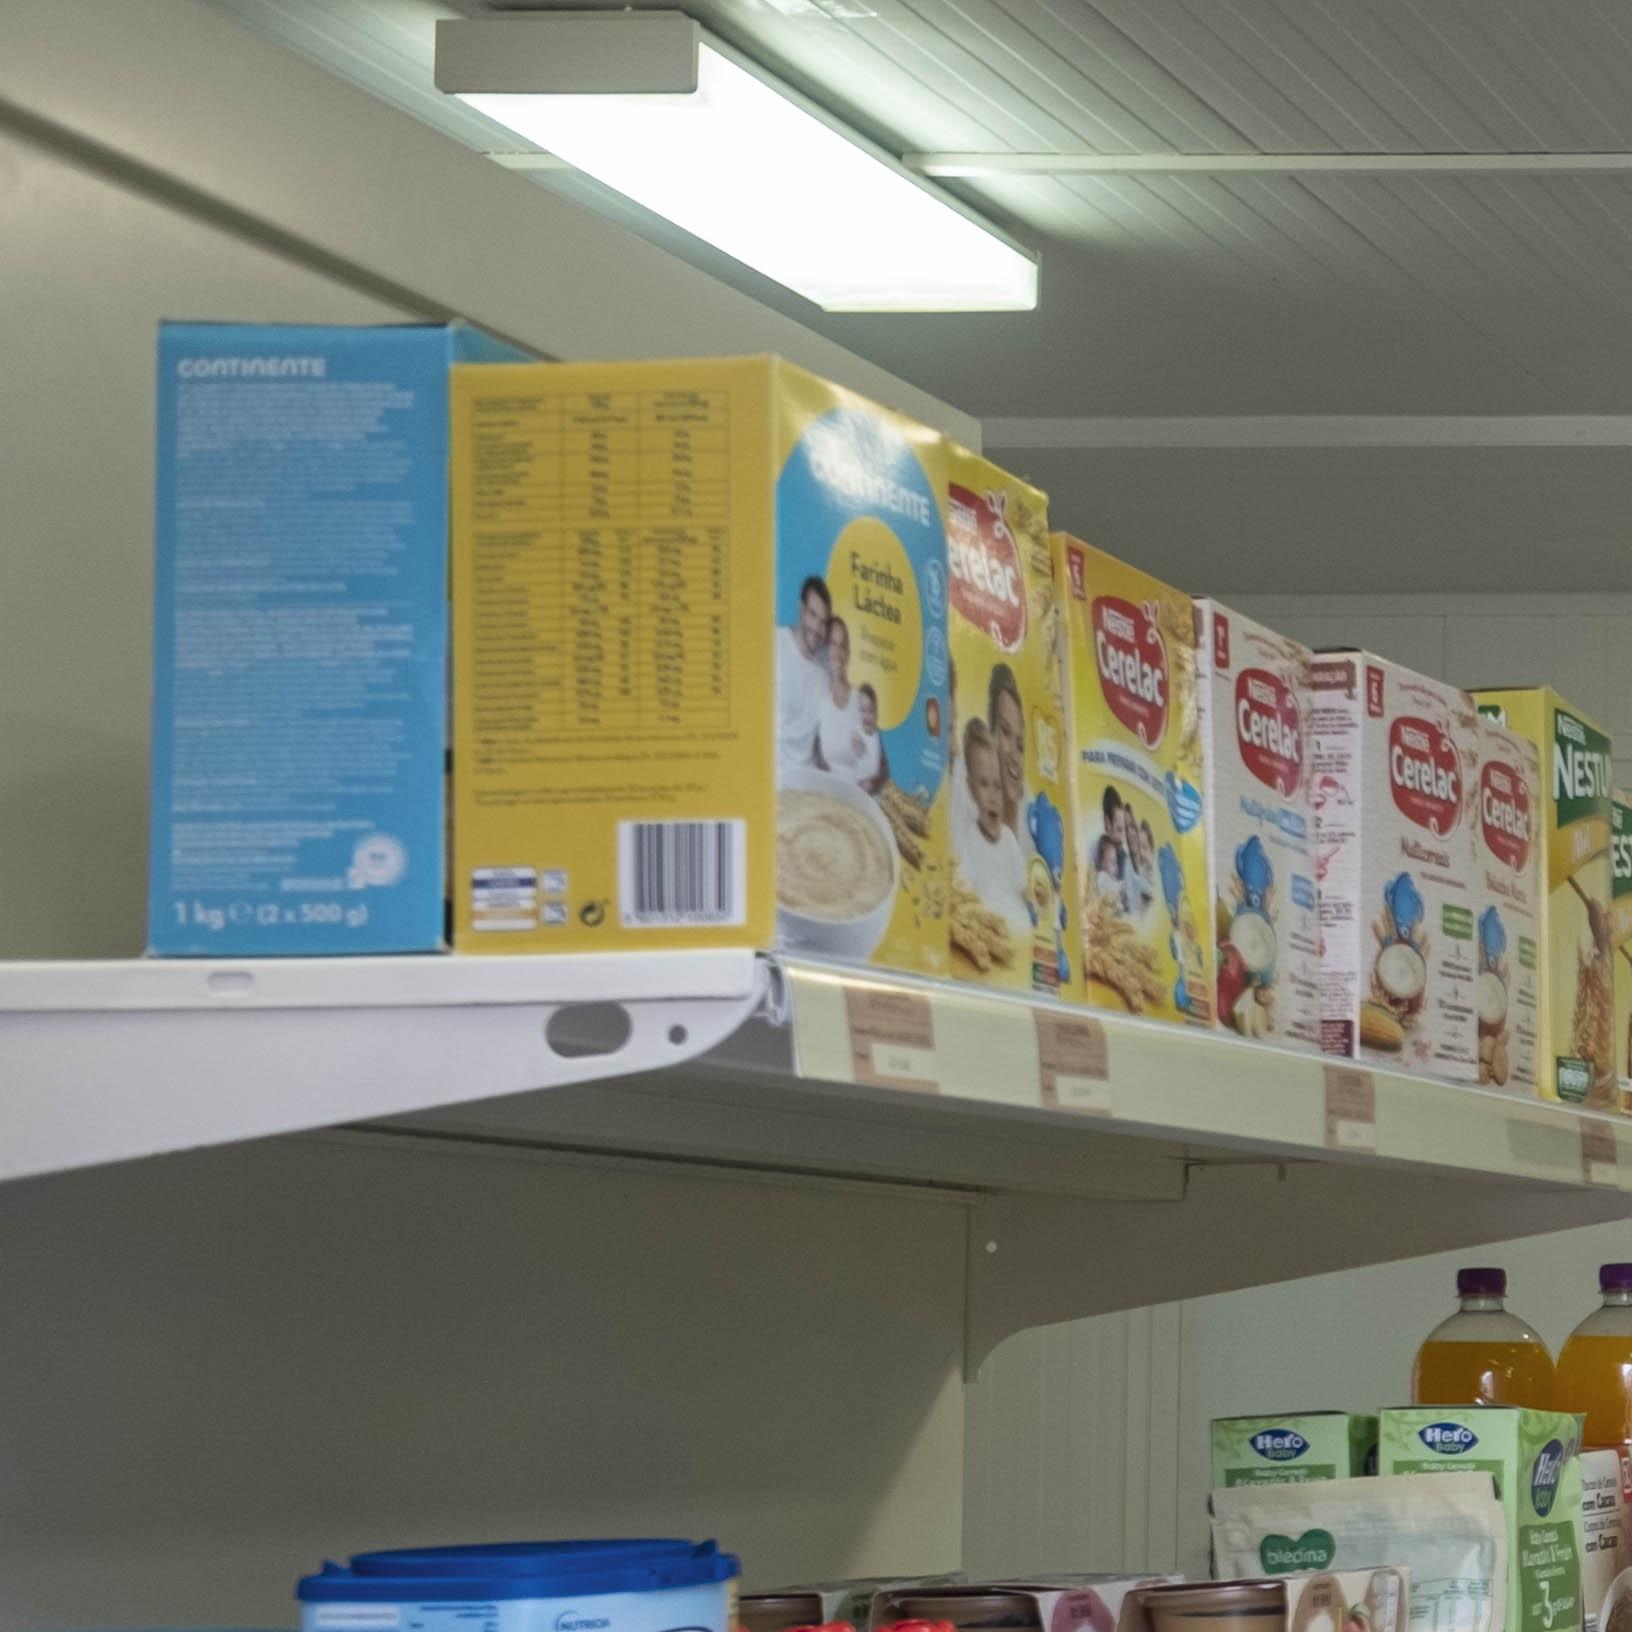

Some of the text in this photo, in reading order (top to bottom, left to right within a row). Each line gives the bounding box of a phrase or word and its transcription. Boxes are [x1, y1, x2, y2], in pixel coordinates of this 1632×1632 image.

[850, 551, 904, 596] Farinha
[949, 528, 1020, 608] erelac
[1096, 630, 1164, 709] Cerelac
[1238, 698, 1300, 763] Cerelac
[1391, 744, 1458, 805] Cerelac
[1552, 742, 1612, 802] NESTU
[1483, 787, 1530, 843] Cerelac
[1255, 1431, 1304, 1450] Hero
[1425, 1426, 1473, 1444] Hero
